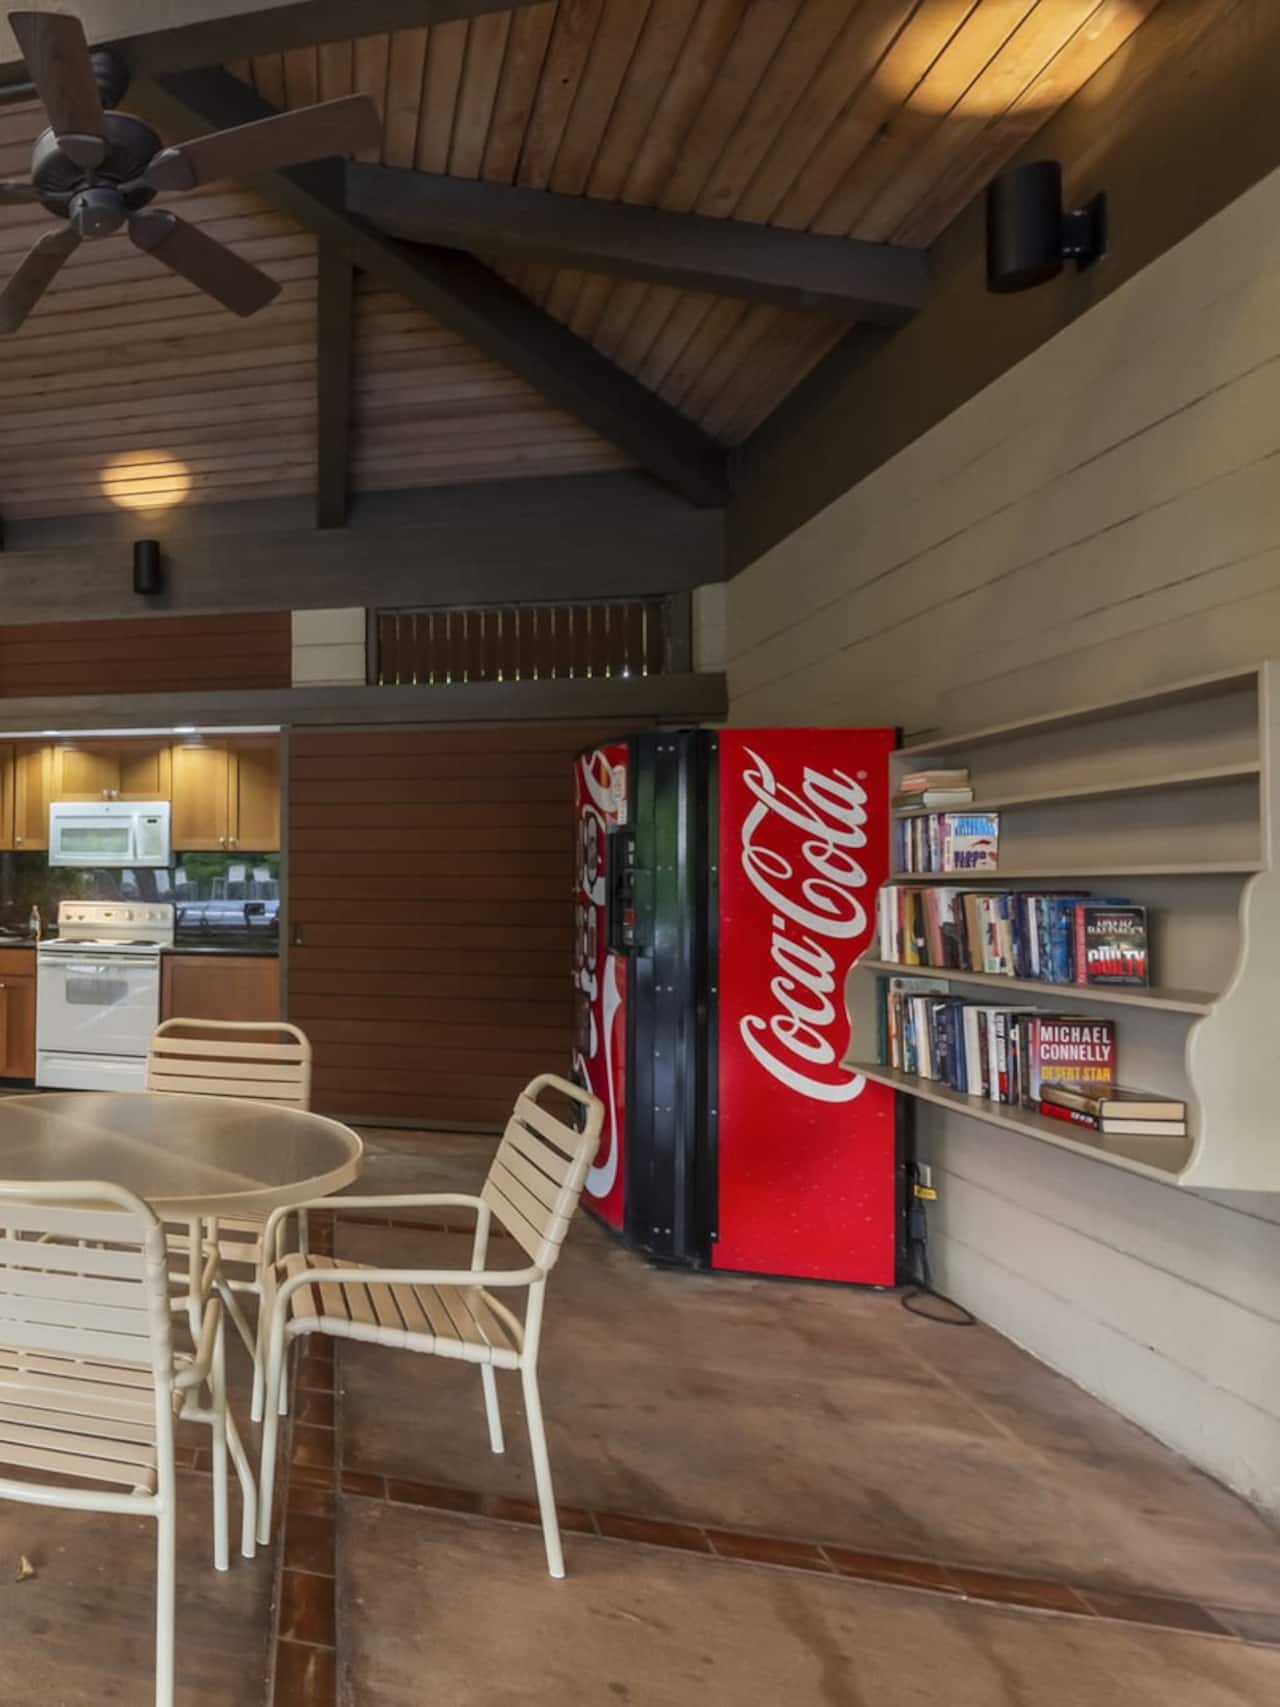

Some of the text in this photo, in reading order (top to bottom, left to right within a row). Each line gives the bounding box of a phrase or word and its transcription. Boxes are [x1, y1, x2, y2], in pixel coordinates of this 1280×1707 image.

[740, 745, 869, 1103] Coca-Cola
[1040, 1026, 1111, 1043] MICHAEL
[1040, 1044, 1111, 1061] CONNELLY
[1040, 1066, 1111, 1082] DESERT STAR
